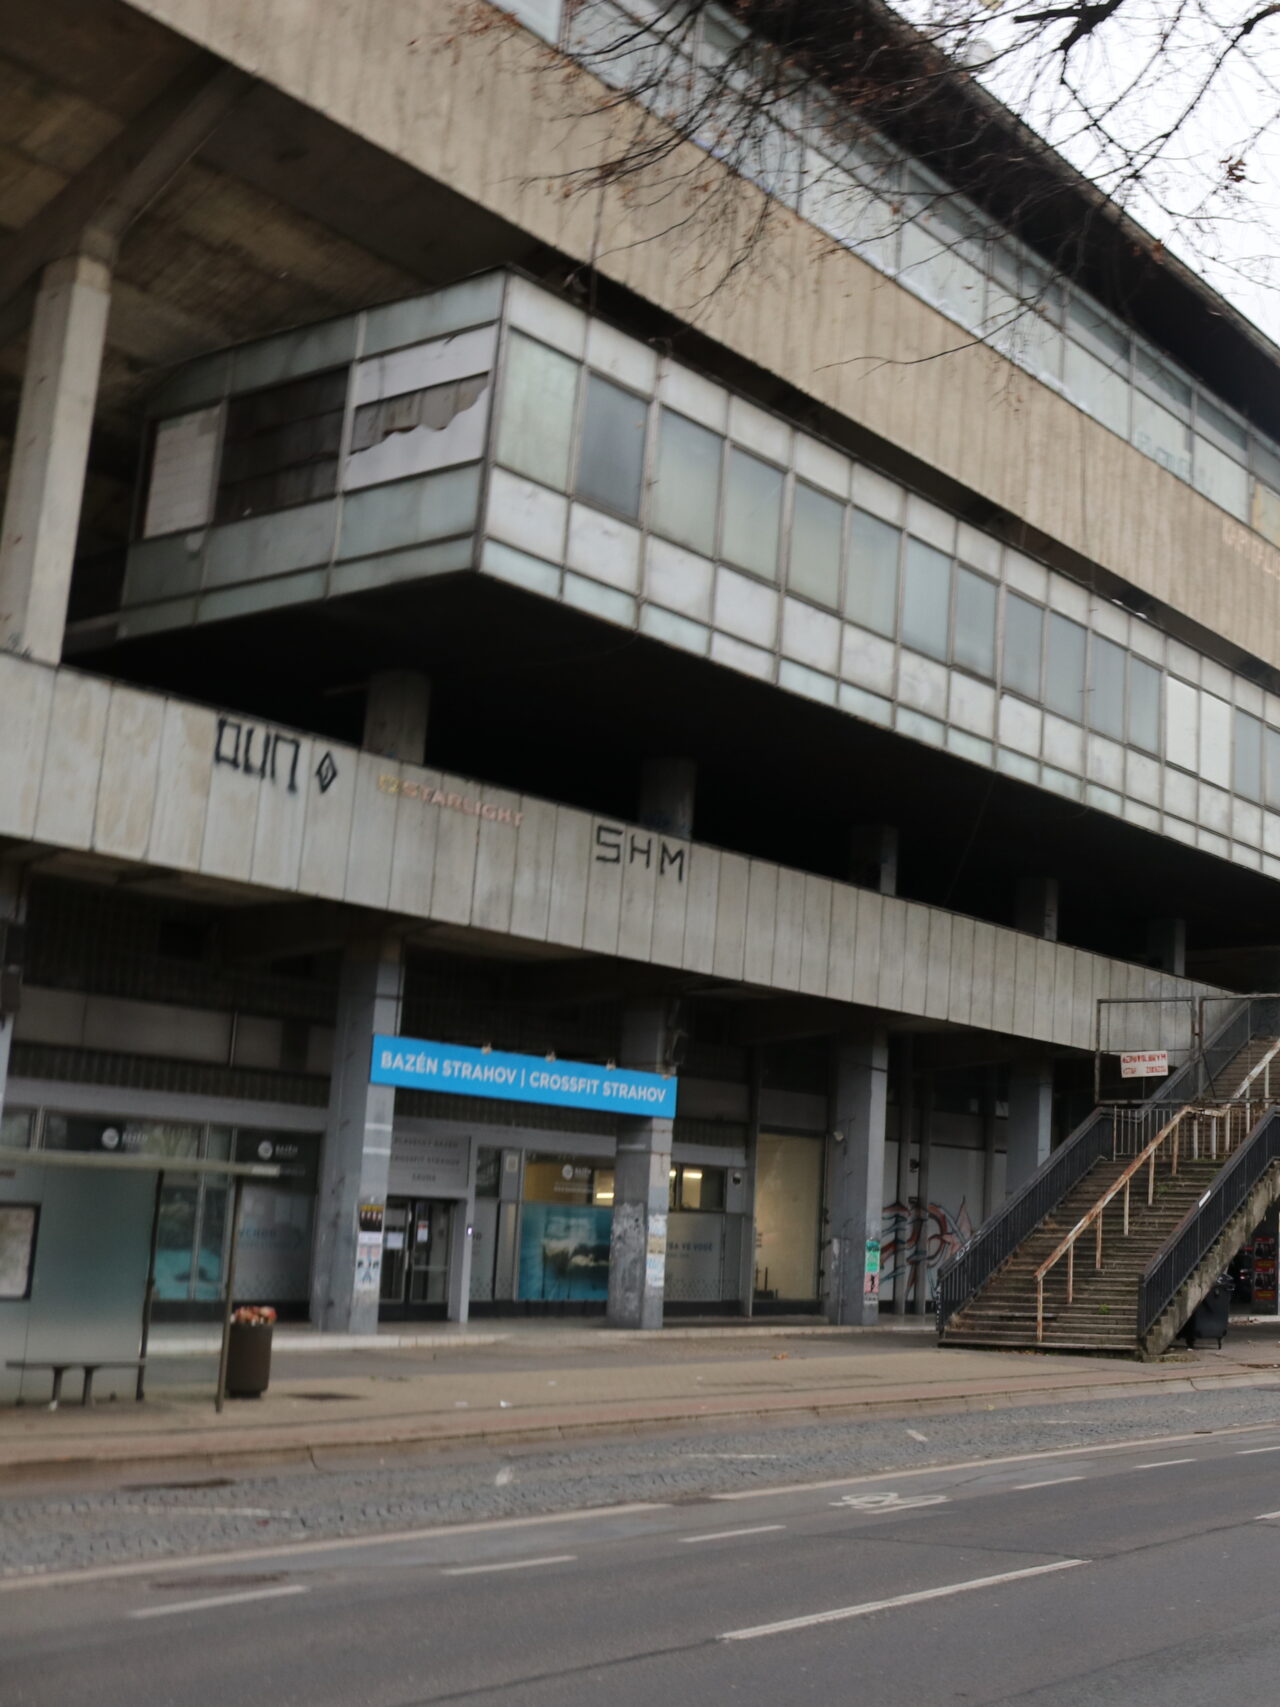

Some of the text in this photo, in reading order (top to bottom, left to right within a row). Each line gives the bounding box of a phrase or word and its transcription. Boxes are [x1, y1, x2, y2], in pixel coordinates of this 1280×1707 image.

[595, 825, 685, 884] SHM
[381, 1050, 666, 1103] BAZÉN STRAHOV CROSSFIT STRAHOV
